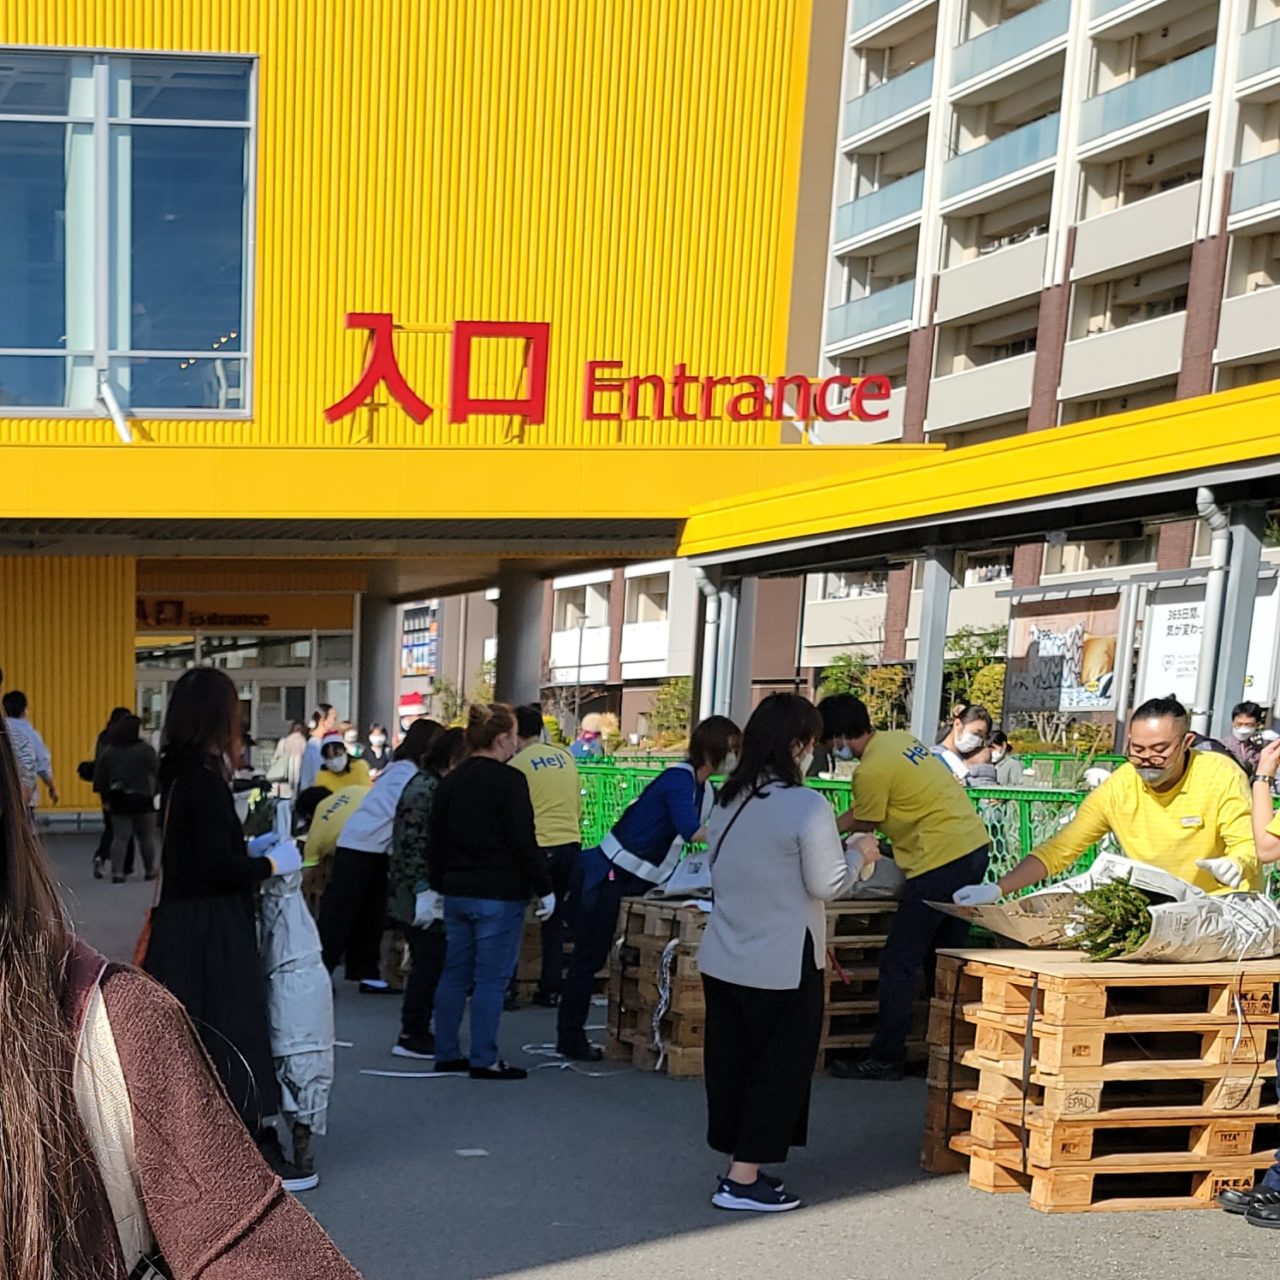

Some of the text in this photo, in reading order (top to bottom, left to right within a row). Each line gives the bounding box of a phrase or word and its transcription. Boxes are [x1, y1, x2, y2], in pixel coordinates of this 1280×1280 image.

[322, 312, 891, 426] 入口 Entrance
[530, 753, 566, 771] Hej!
[1214, 1178, 1252, 1188] IKEA
